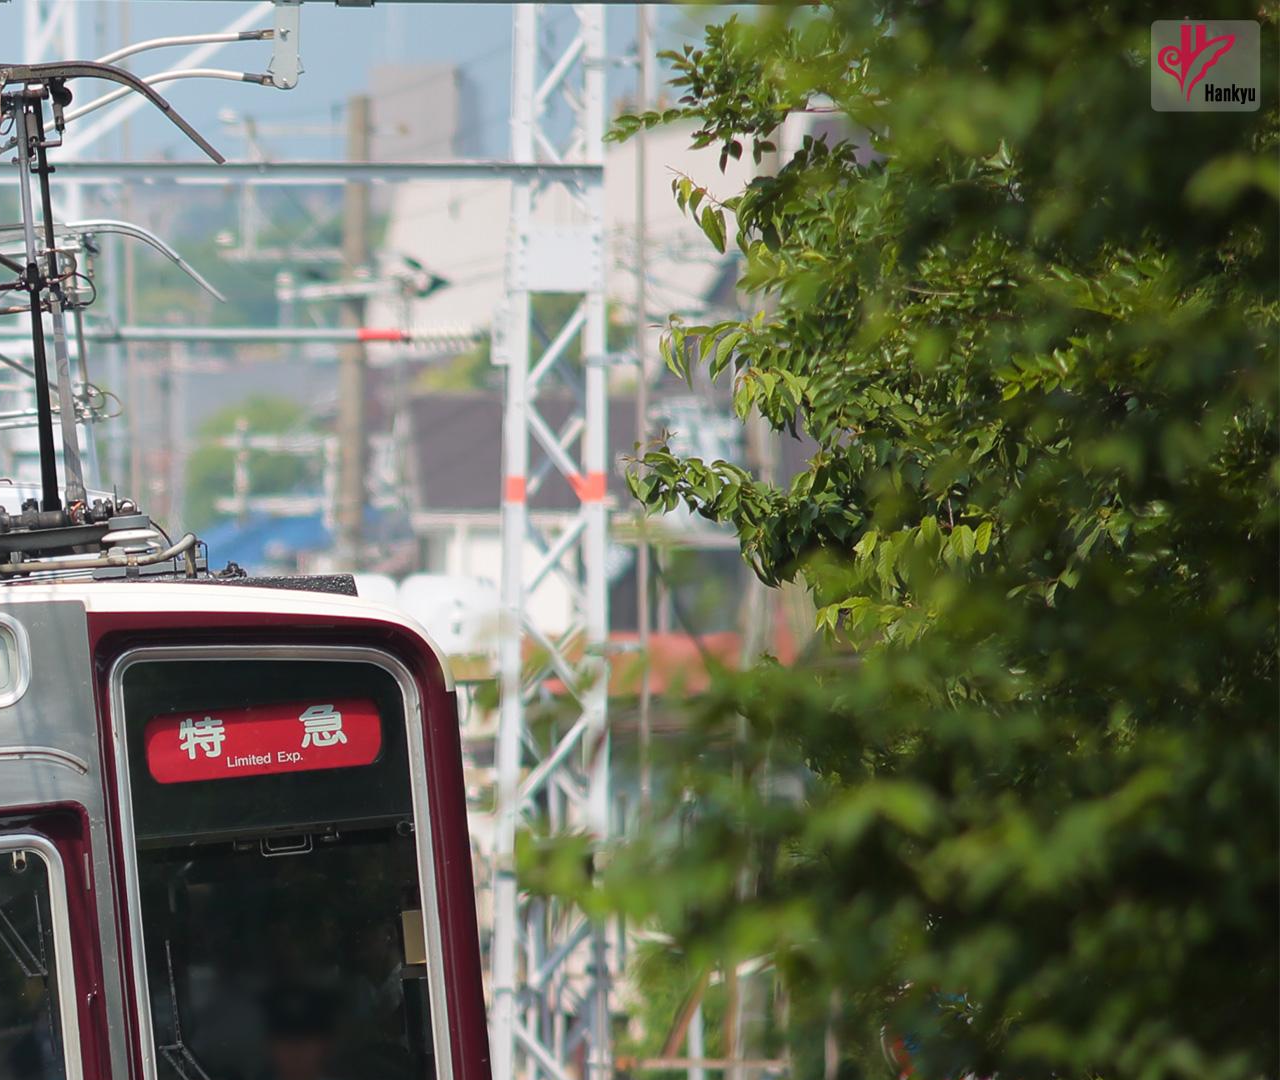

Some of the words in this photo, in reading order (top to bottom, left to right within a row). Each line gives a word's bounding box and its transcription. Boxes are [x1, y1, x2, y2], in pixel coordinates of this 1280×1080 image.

[179, 704, 348, 760] 特急
[226, 752, 272, 768] Limited
[277, 751, 304, 763] Exp.
